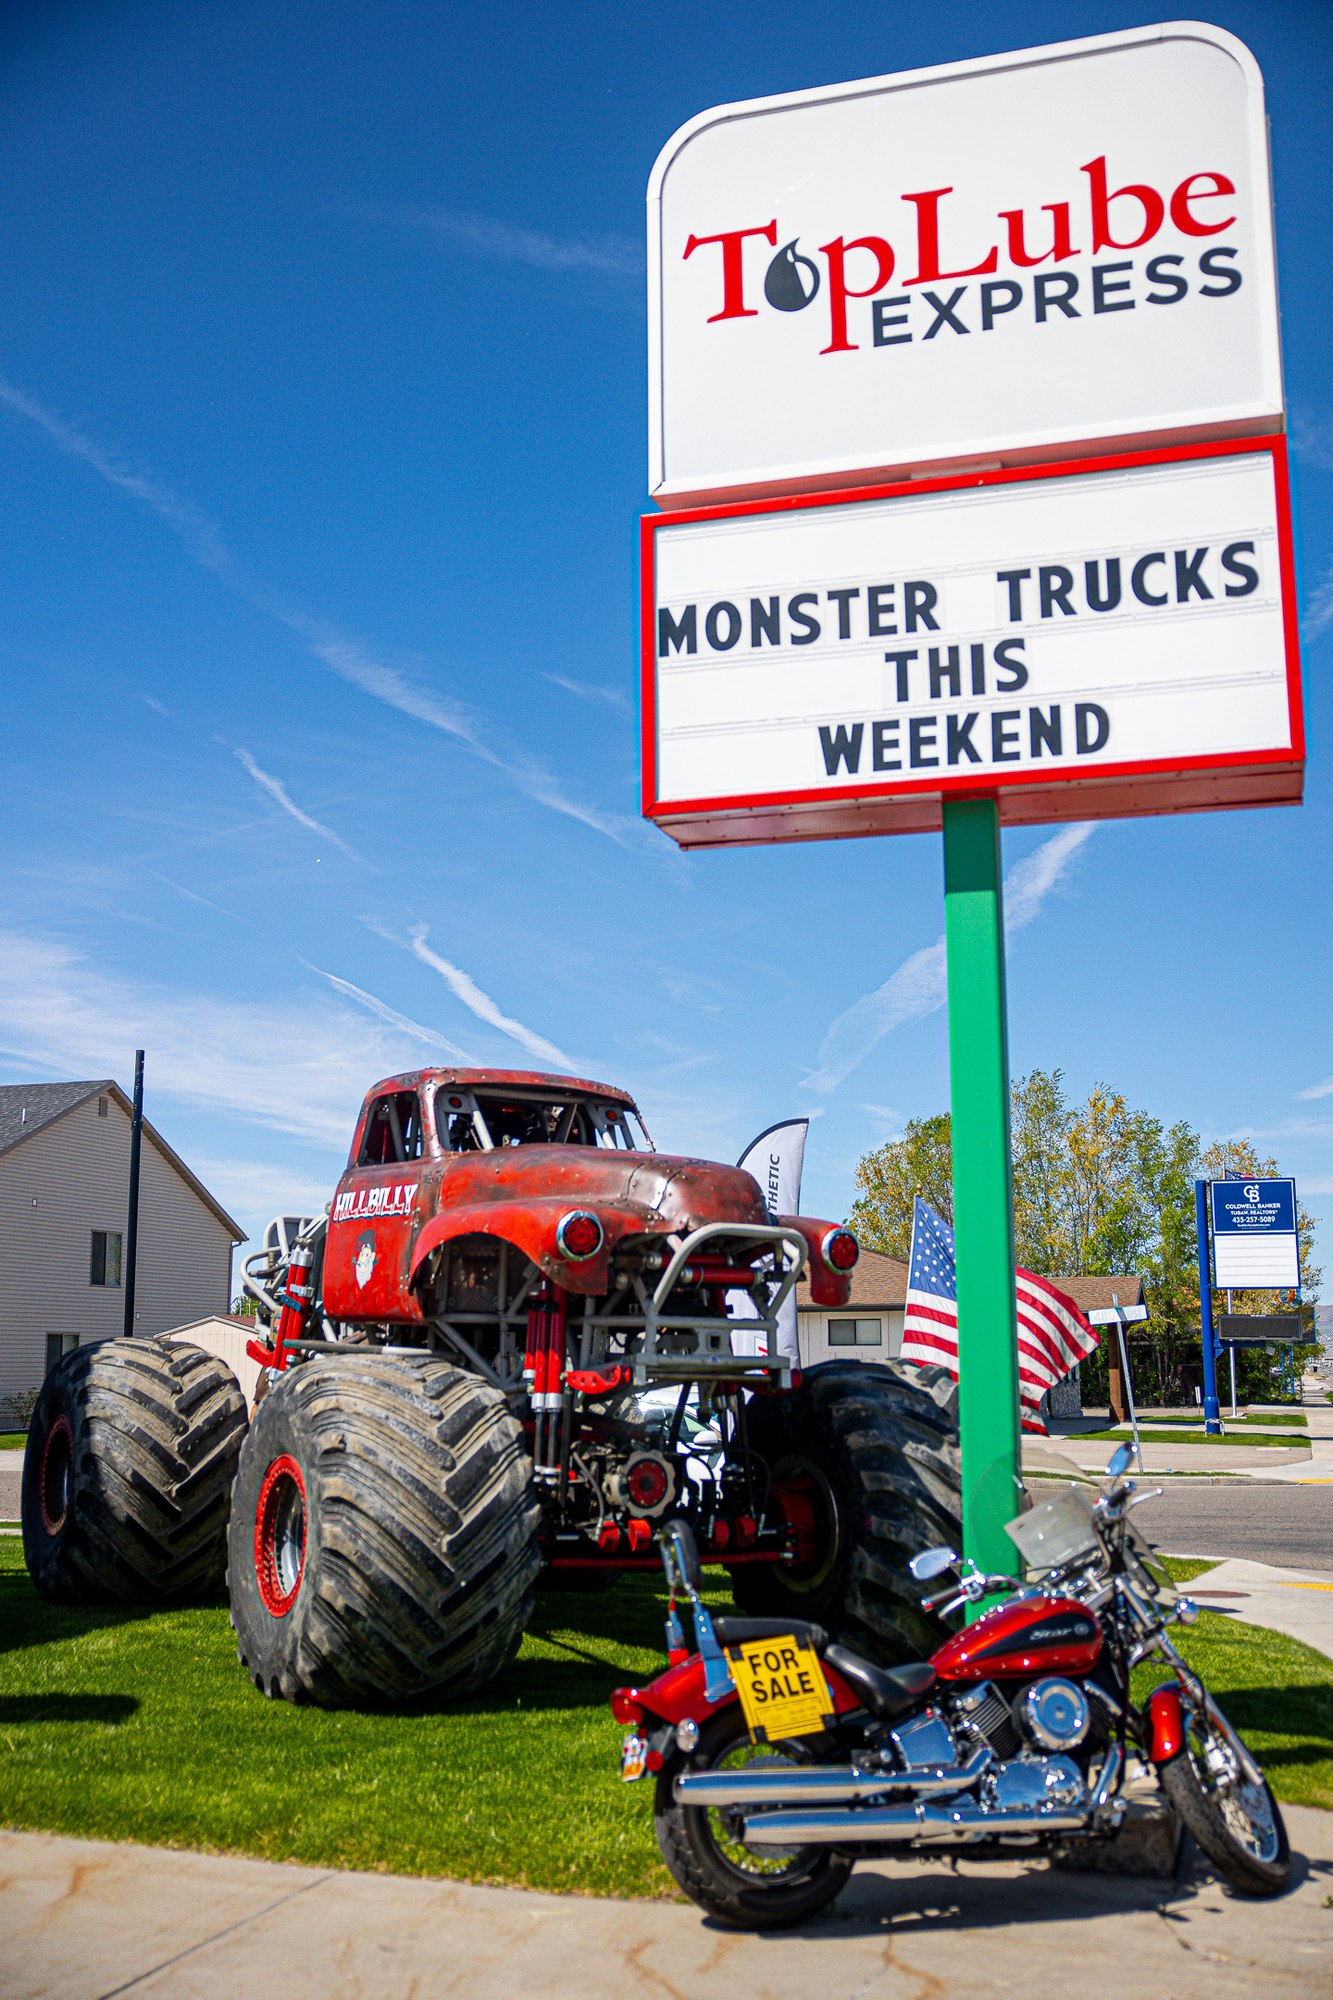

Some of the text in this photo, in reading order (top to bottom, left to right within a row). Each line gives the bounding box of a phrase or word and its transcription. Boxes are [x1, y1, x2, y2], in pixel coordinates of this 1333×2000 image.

[682, 155, 1238, 355] TopLube
[871, 246, 1243, 349] EXPRESS
[658, 541, 1260, 658] MONSTER TRUCKS
[885, 638, 1030, 703] THIS
[818, 702, 1111, 776] WEEKEND
[333, 1184, 418, 1222] HILLBILLY
[748, 1648, 800, 1677] FOR
[751, 1671, 815, 1703] SALE
